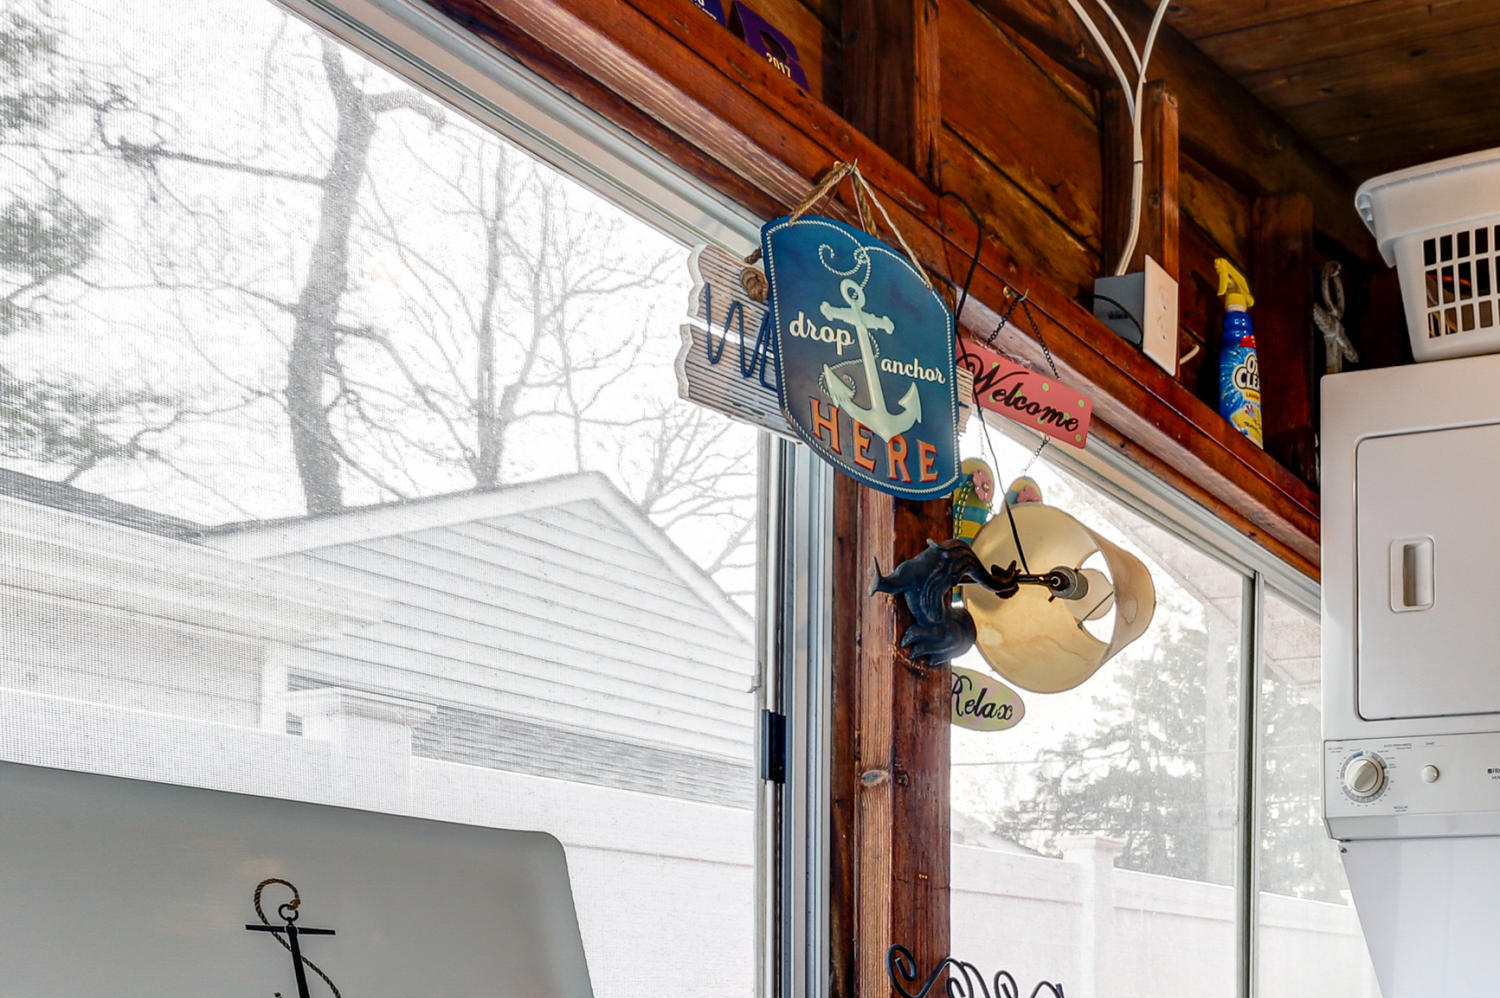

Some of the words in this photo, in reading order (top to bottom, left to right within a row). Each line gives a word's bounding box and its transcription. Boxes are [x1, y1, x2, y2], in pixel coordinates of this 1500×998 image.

[789, 312, 855, 355] drop
[880, 357, 946, 386] anchor
[964, 353, 1080, 432] Welcome
[808, 397, 939, 484] HERE
[951, 671, 1013, 721] Relax
